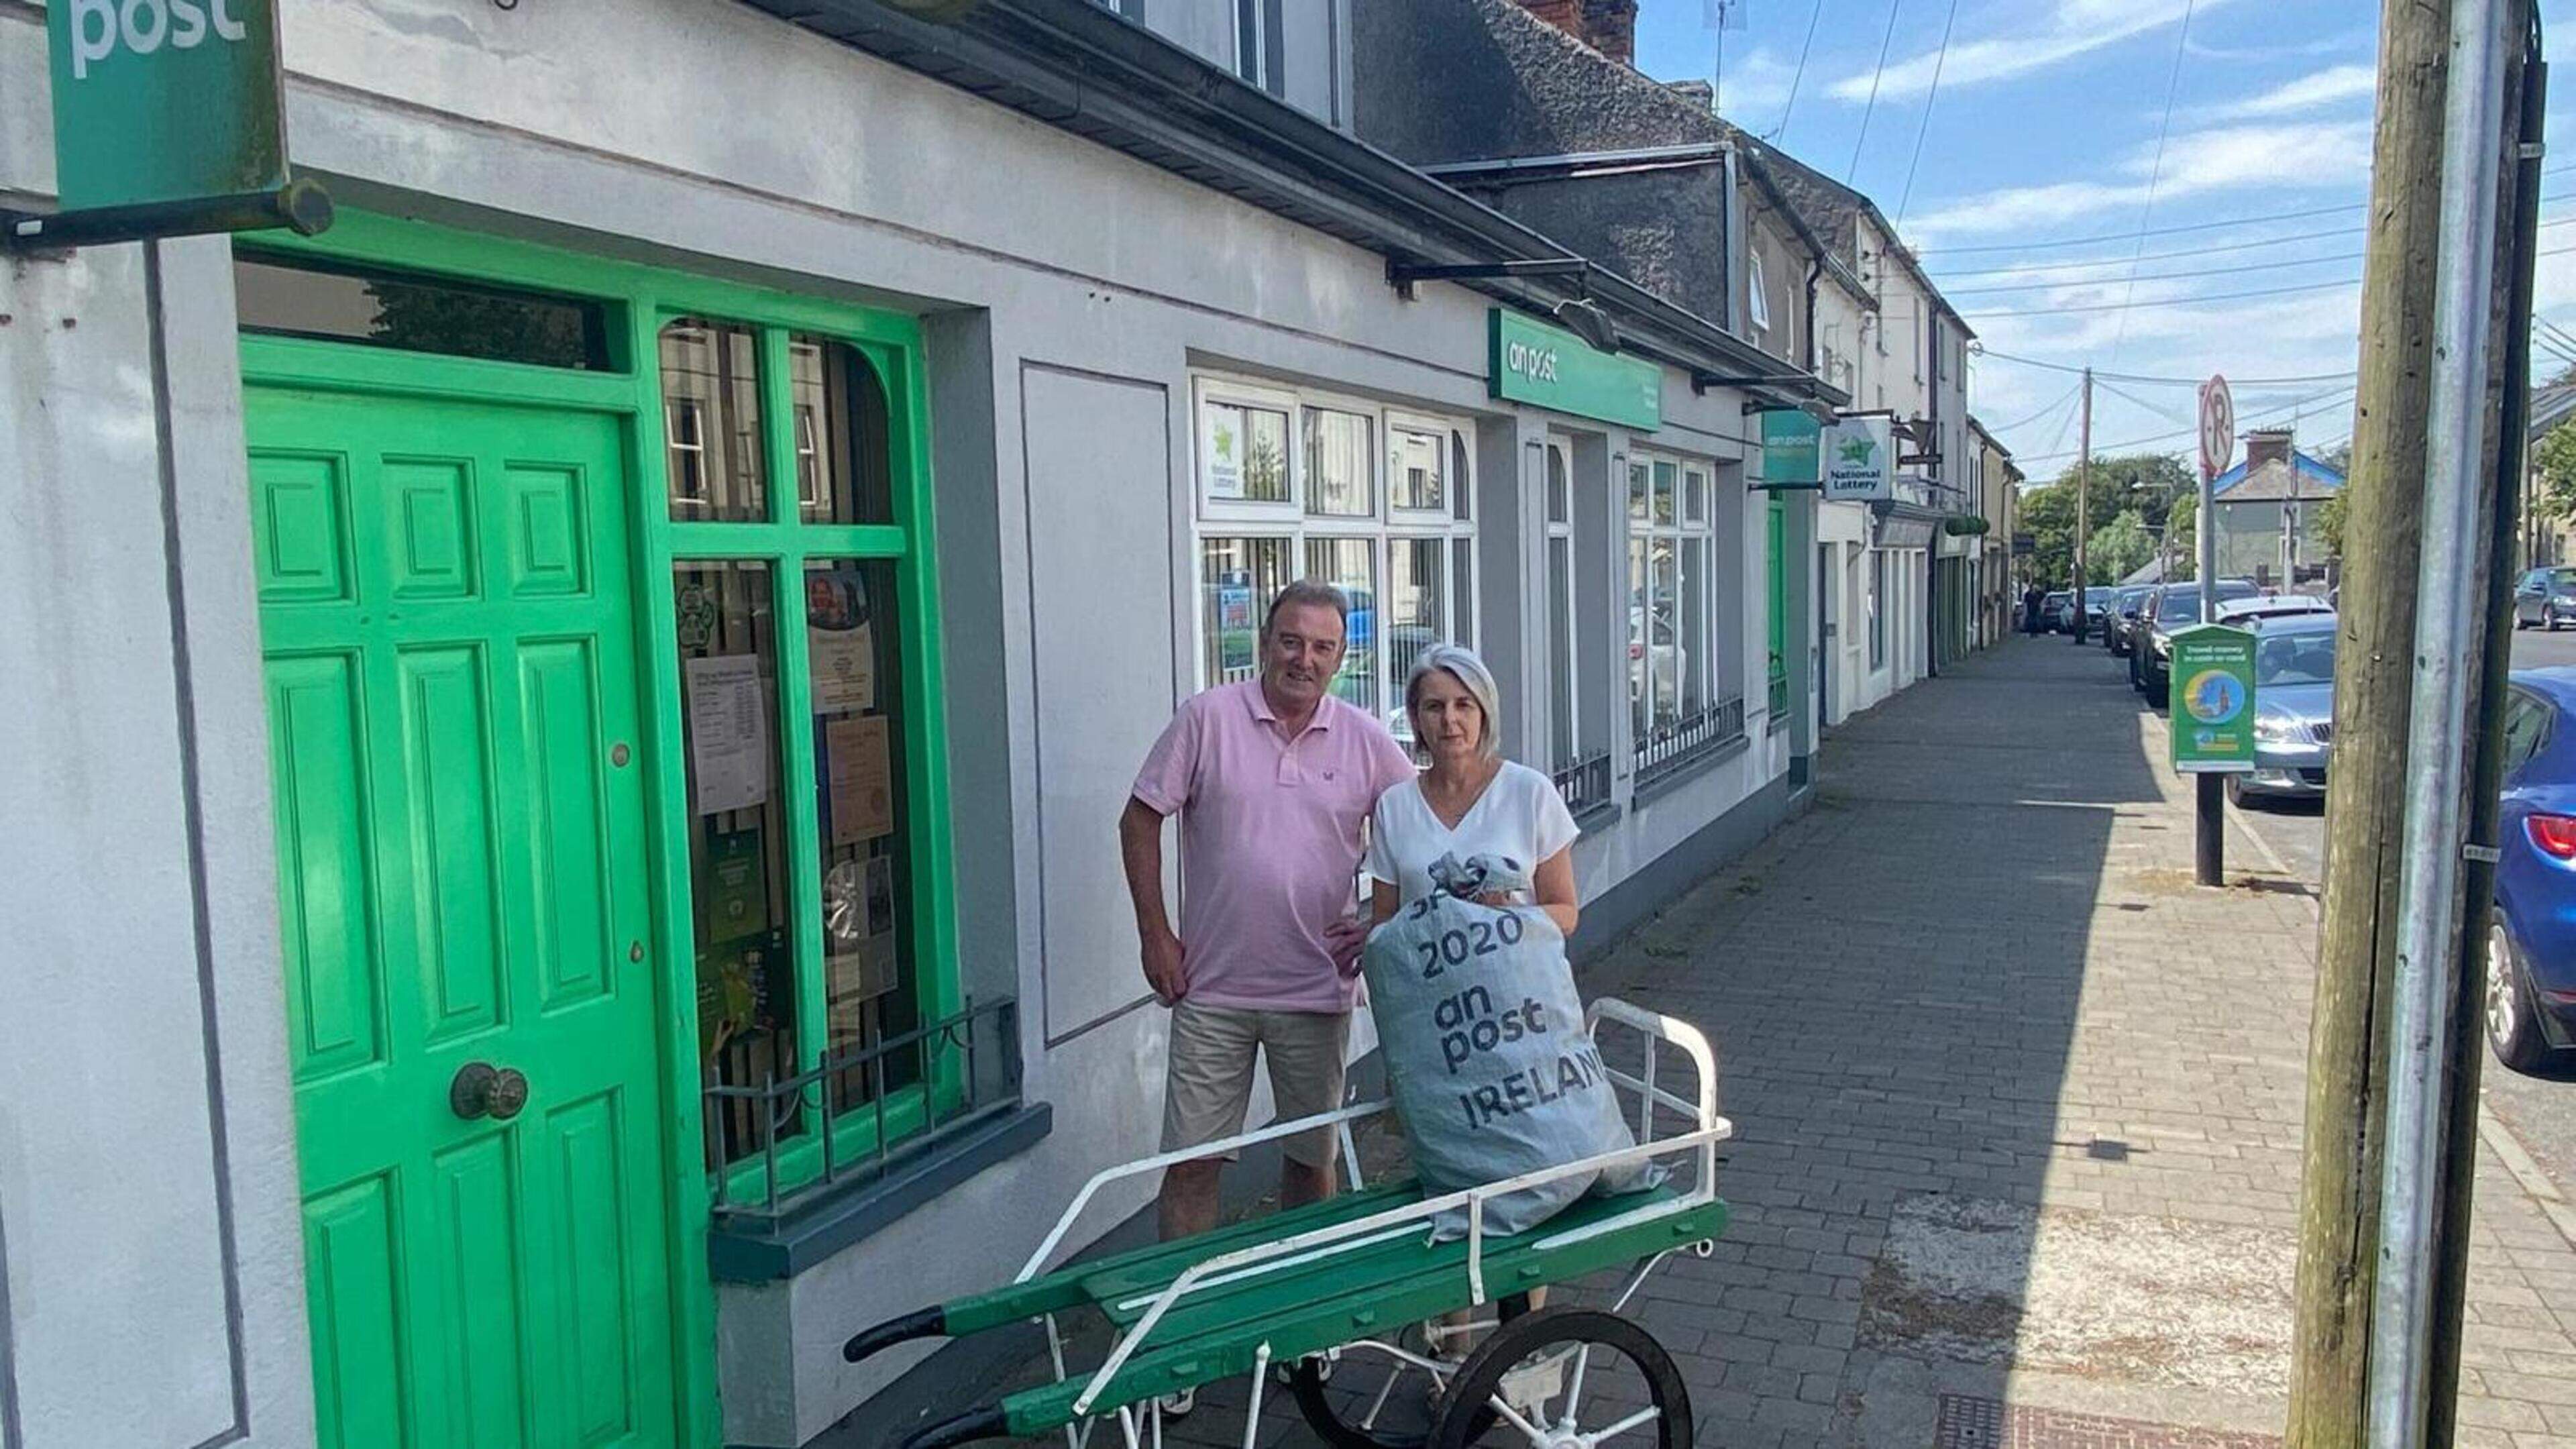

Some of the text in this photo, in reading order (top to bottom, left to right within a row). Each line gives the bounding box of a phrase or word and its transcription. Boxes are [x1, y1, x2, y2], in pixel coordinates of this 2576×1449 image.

[1830, 468, 1881, 480] National
[1833, 479, 1878, 491] Lottery
[1417, 912, 1523, 980] 2020
[1434, 985, 1493, 1030] an
[1440, 997, 1547, 1075] post
